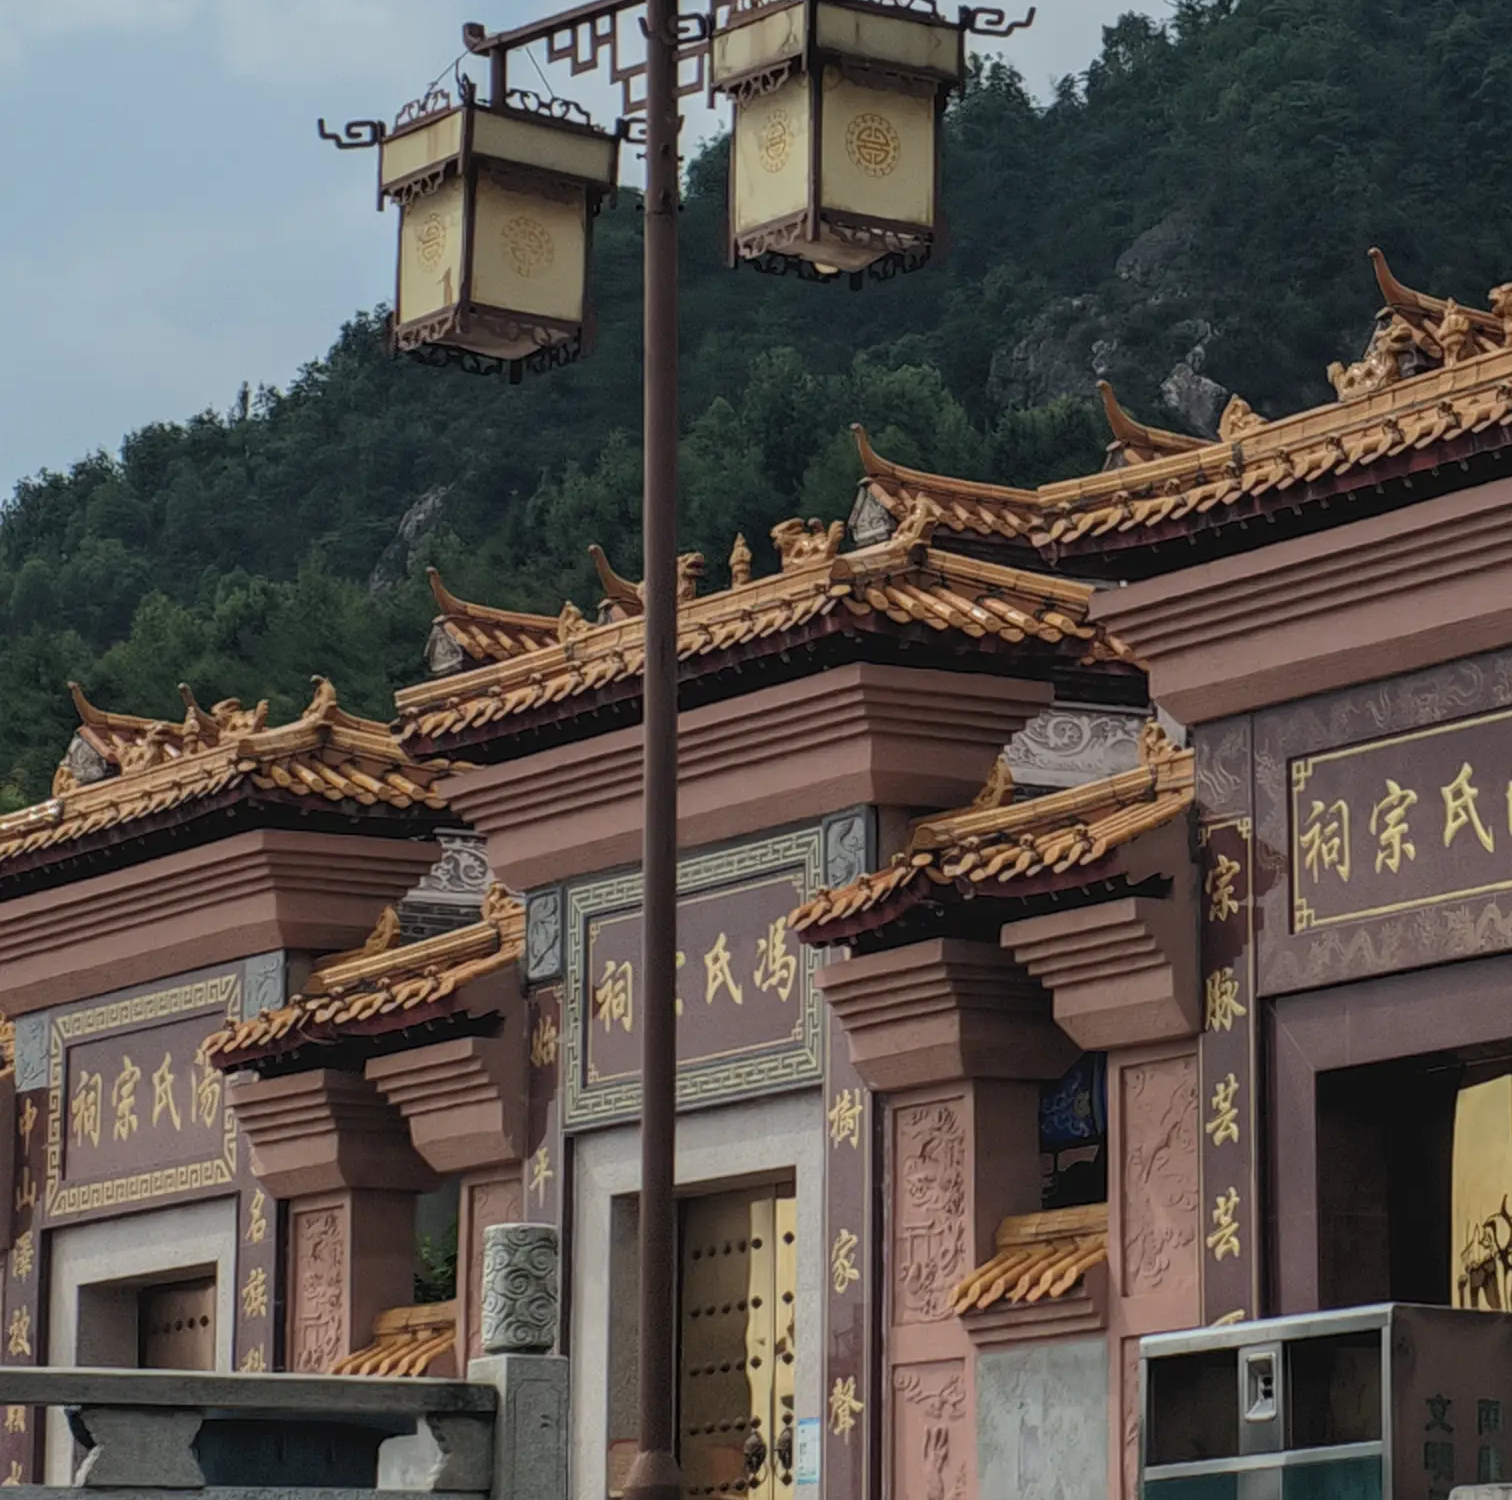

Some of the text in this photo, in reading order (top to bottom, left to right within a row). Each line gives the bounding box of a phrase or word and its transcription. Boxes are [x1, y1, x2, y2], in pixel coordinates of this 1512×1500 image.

[595, 915, 798, 1034] 馮氏祠
[1204, 853, 1248, 1327] 宗脈芸芸
